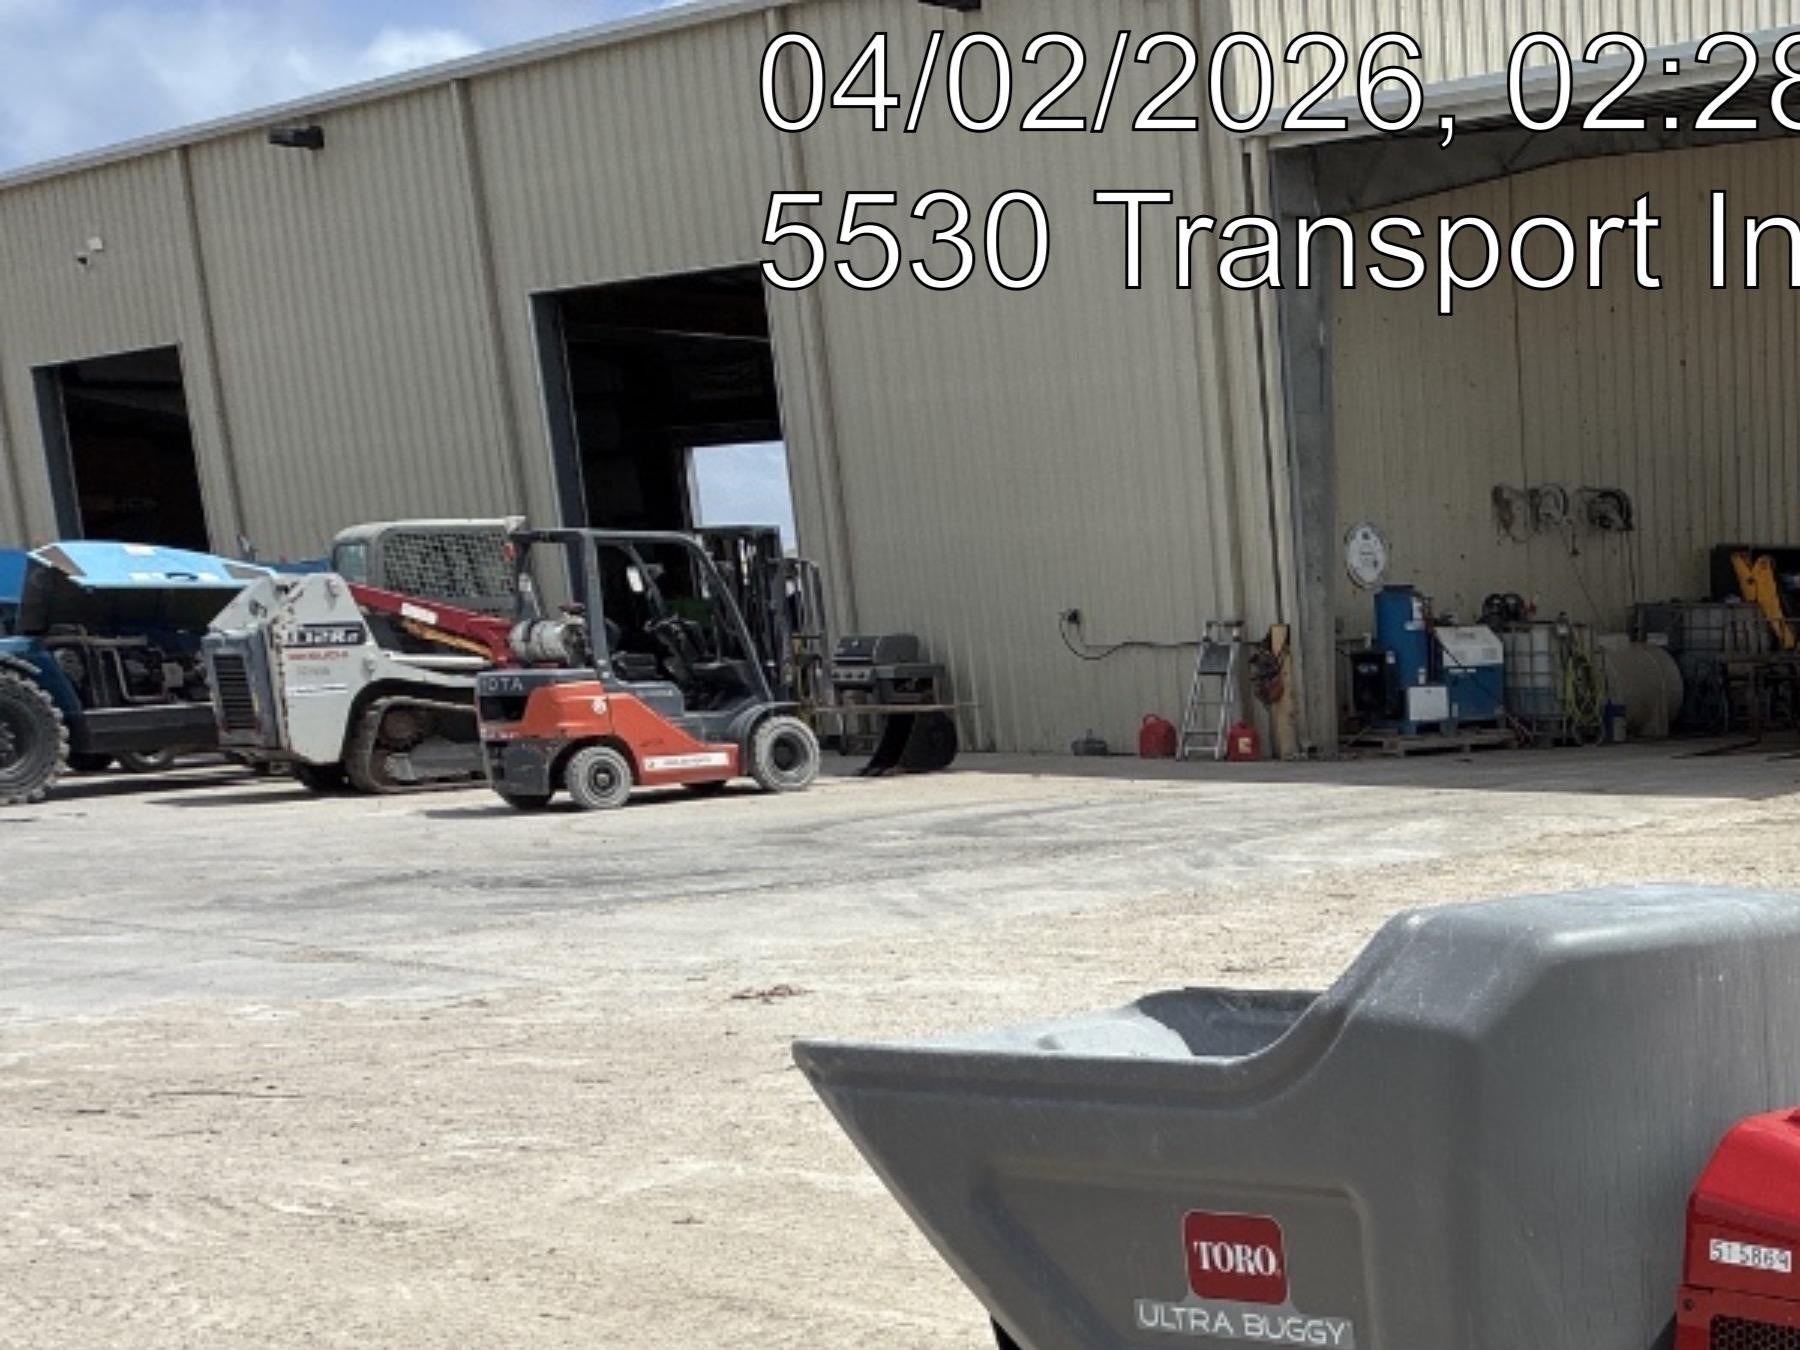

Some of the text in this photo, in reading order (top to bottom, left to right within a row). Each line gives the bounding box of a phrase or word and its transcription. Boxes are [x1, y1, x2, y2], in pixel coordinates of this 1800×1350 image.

[1192, 1239, 1280, 1277] TORO
[1138, 1303, 1346, 1346] ULTRA BUGGY
